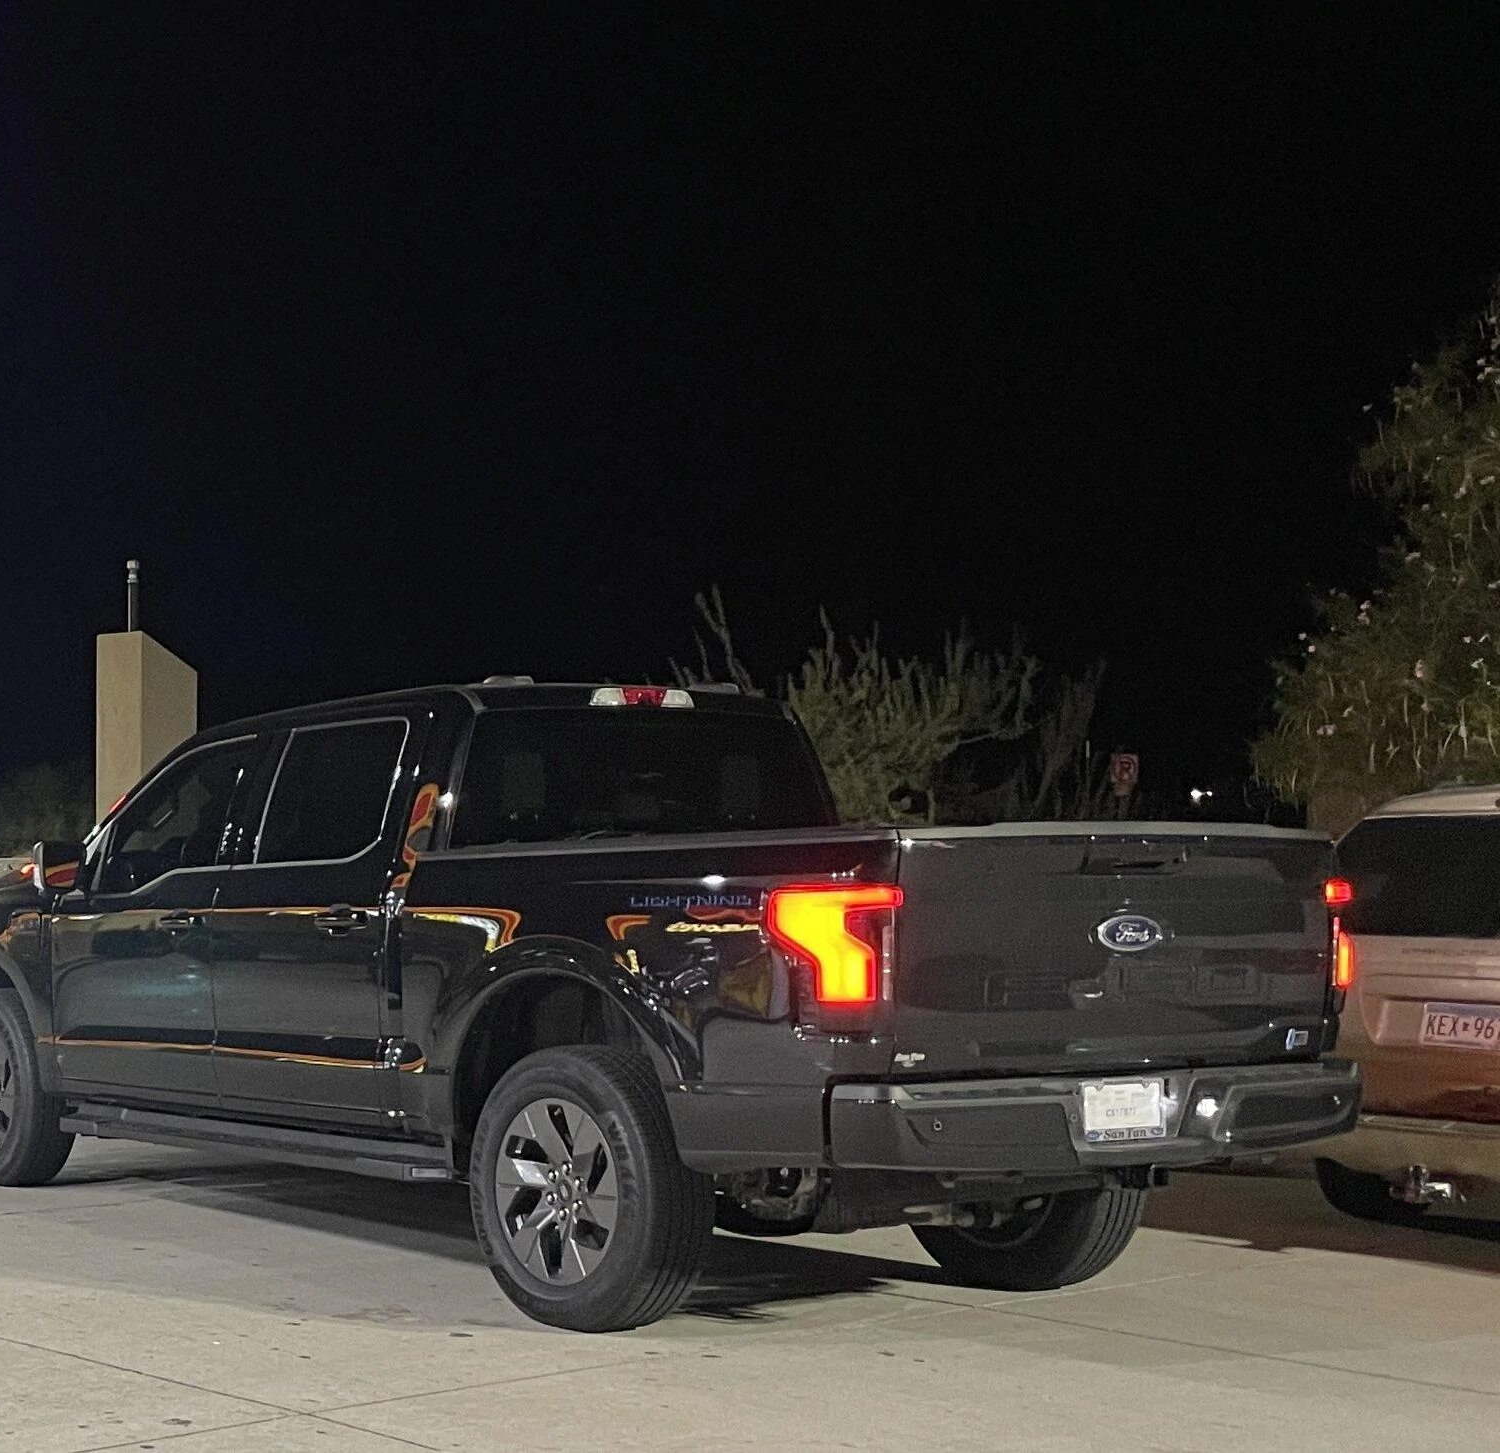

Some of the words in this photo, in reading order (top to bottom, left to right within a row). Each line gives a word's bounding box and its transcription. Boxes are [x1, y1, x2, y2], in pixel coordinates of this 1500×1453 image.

[630, 894, 751, 908] LIGHTNING
[1116, 921, 1151, 942] Ford
[1425, 1013, 1460, 1037] KEX
[1474, 1016, 1500, 1041] 96
[1103, 1129, 1125, 1139] San
[1127, 1128, 1147, 1138] Tan
